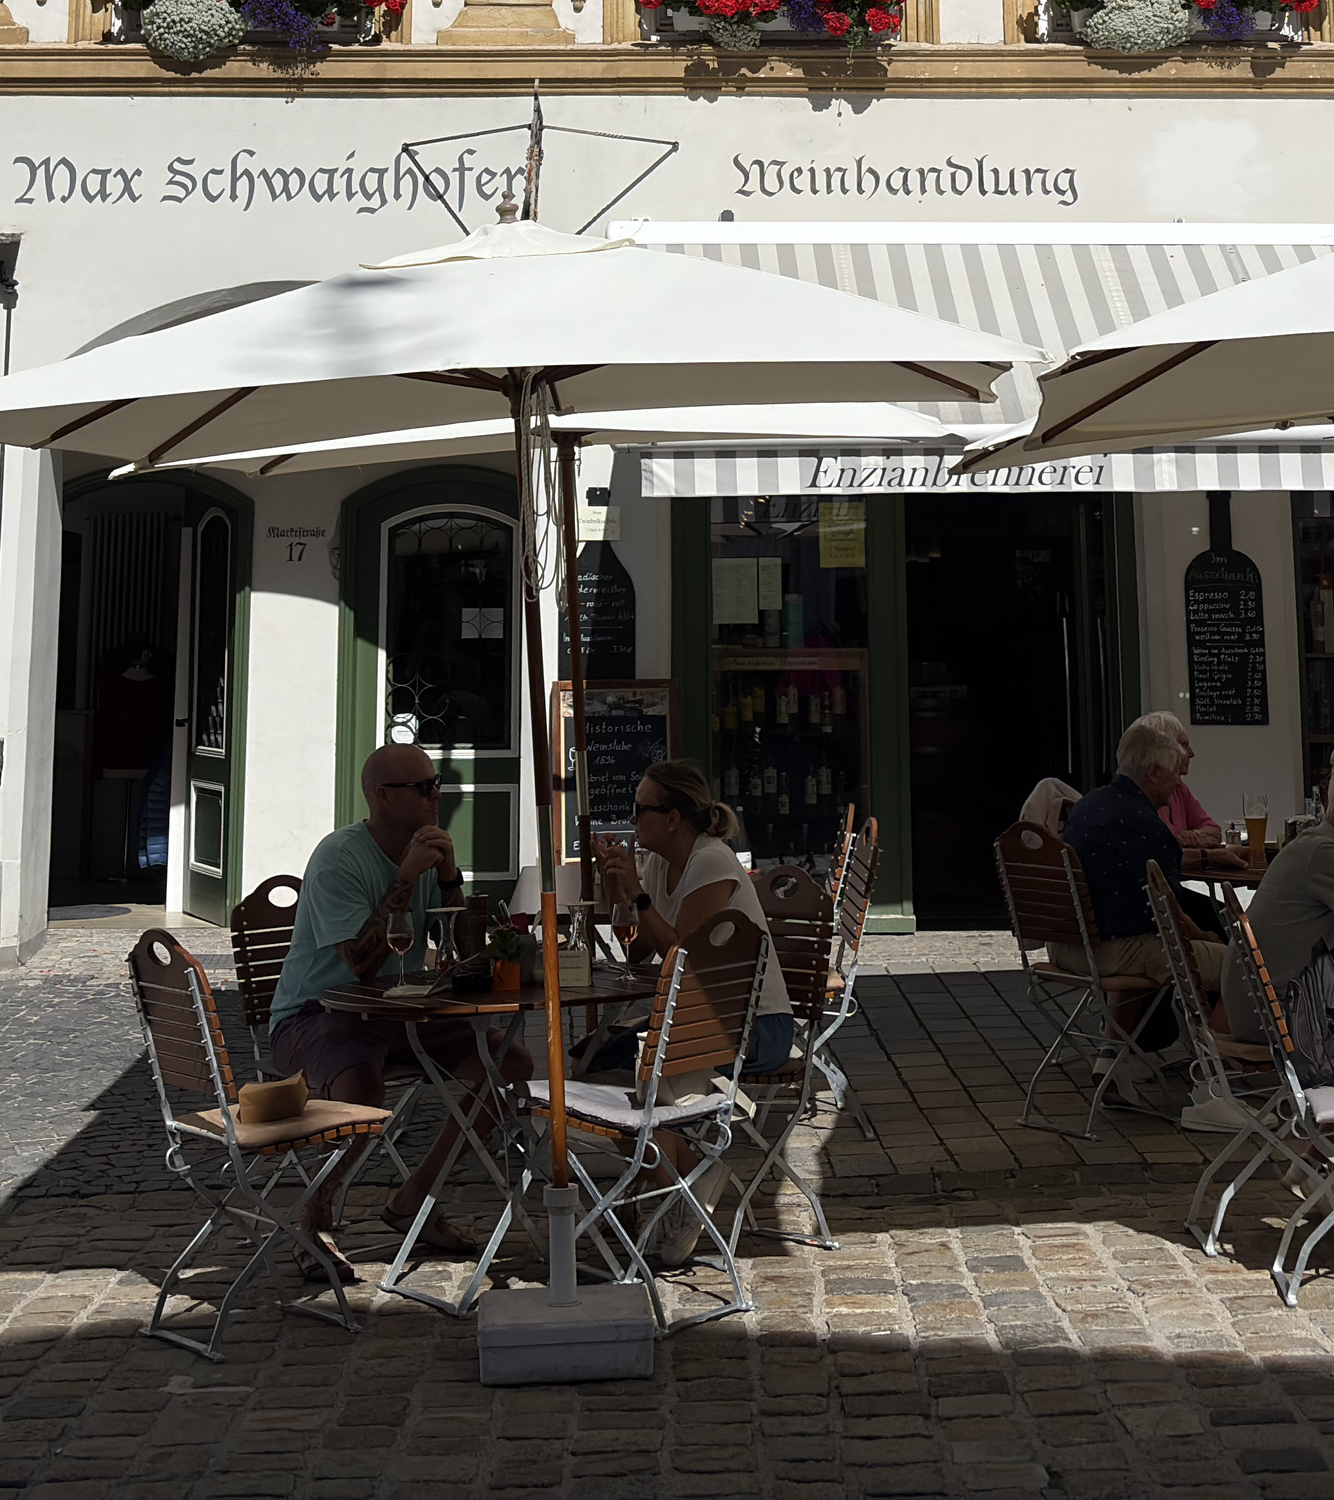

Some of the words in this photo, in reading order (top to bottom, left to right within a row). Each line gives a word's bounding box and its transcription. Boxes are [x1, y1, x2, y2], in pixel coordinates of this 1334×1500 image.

[13, 156, 143, 204] Max
[160, 149, 528, 214] Schwaighofer
[733, 153, 1078, 205] Weinhandlung
[806, 454, 1107, 489] Enzianbrennerei
[286, 541, 307, 562] 17
[1189, 590, 1229, 602] Espresso
[1190, 611, 1209, 620] Latte
[589, 784, 633, 799] geöffnet
